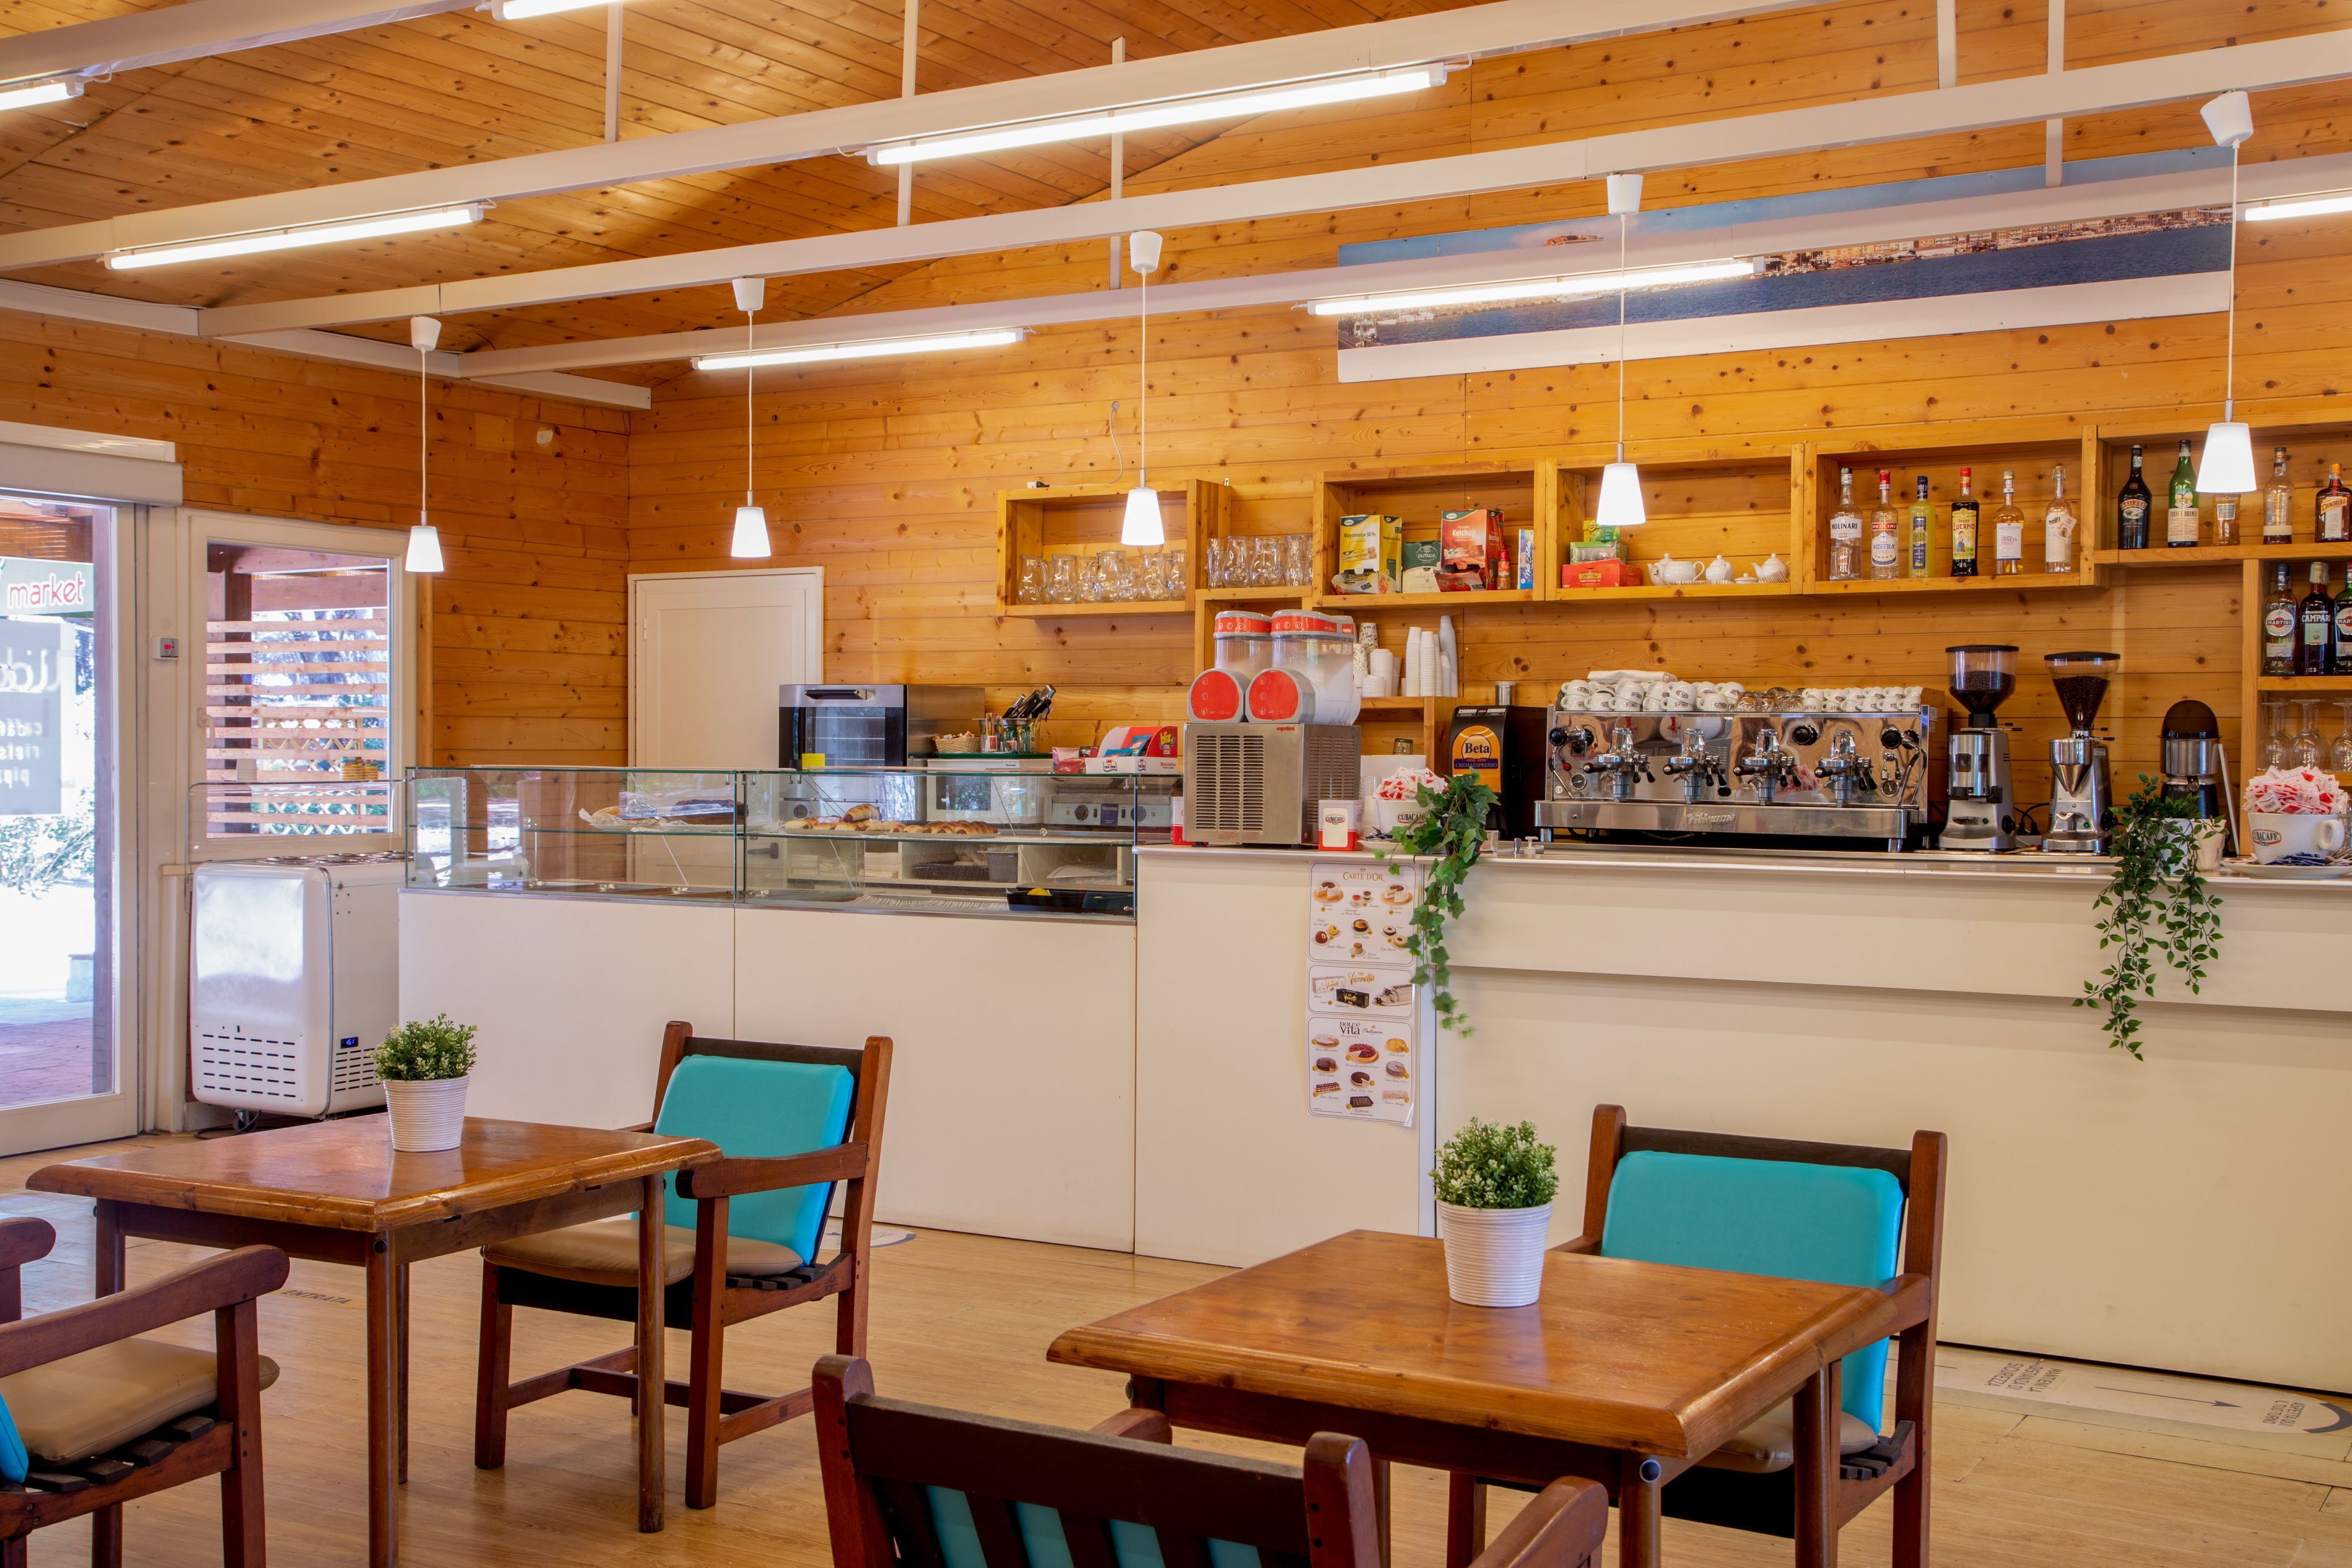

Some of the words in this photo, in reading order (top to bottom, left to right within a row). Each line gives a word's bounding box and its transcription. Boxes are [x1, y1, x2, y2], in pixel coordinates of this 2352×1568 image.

[2121, 500, 2146, 508] BAILEYS
[1953, 523, 1975, 531] LUCANO
[1452, 529, 1476, 538] Ketchup
[8, 573, 85, 607] market
[2302, 614, 2330, 622] CAMPARI
[1465, 743, 1490, 754] Beta
[1343, 871, 1364, 881] CARTE
[1366, 872, 1385, 882] D'OR
[1348, 970, 1375, 986] Viennetta
[1340, 1026, 1361, 1035] Vita
[281, 1290, 353, 1304] ENTRATA
[1984, 1362, 2024, 1387] SICUREZZA
[2011, 1365, 2044, 1385] DISTANZA
[2033, 1369, 2064, 1388] MANTIENI
[2283, 1401, 2307, 1419] ASPETTA
